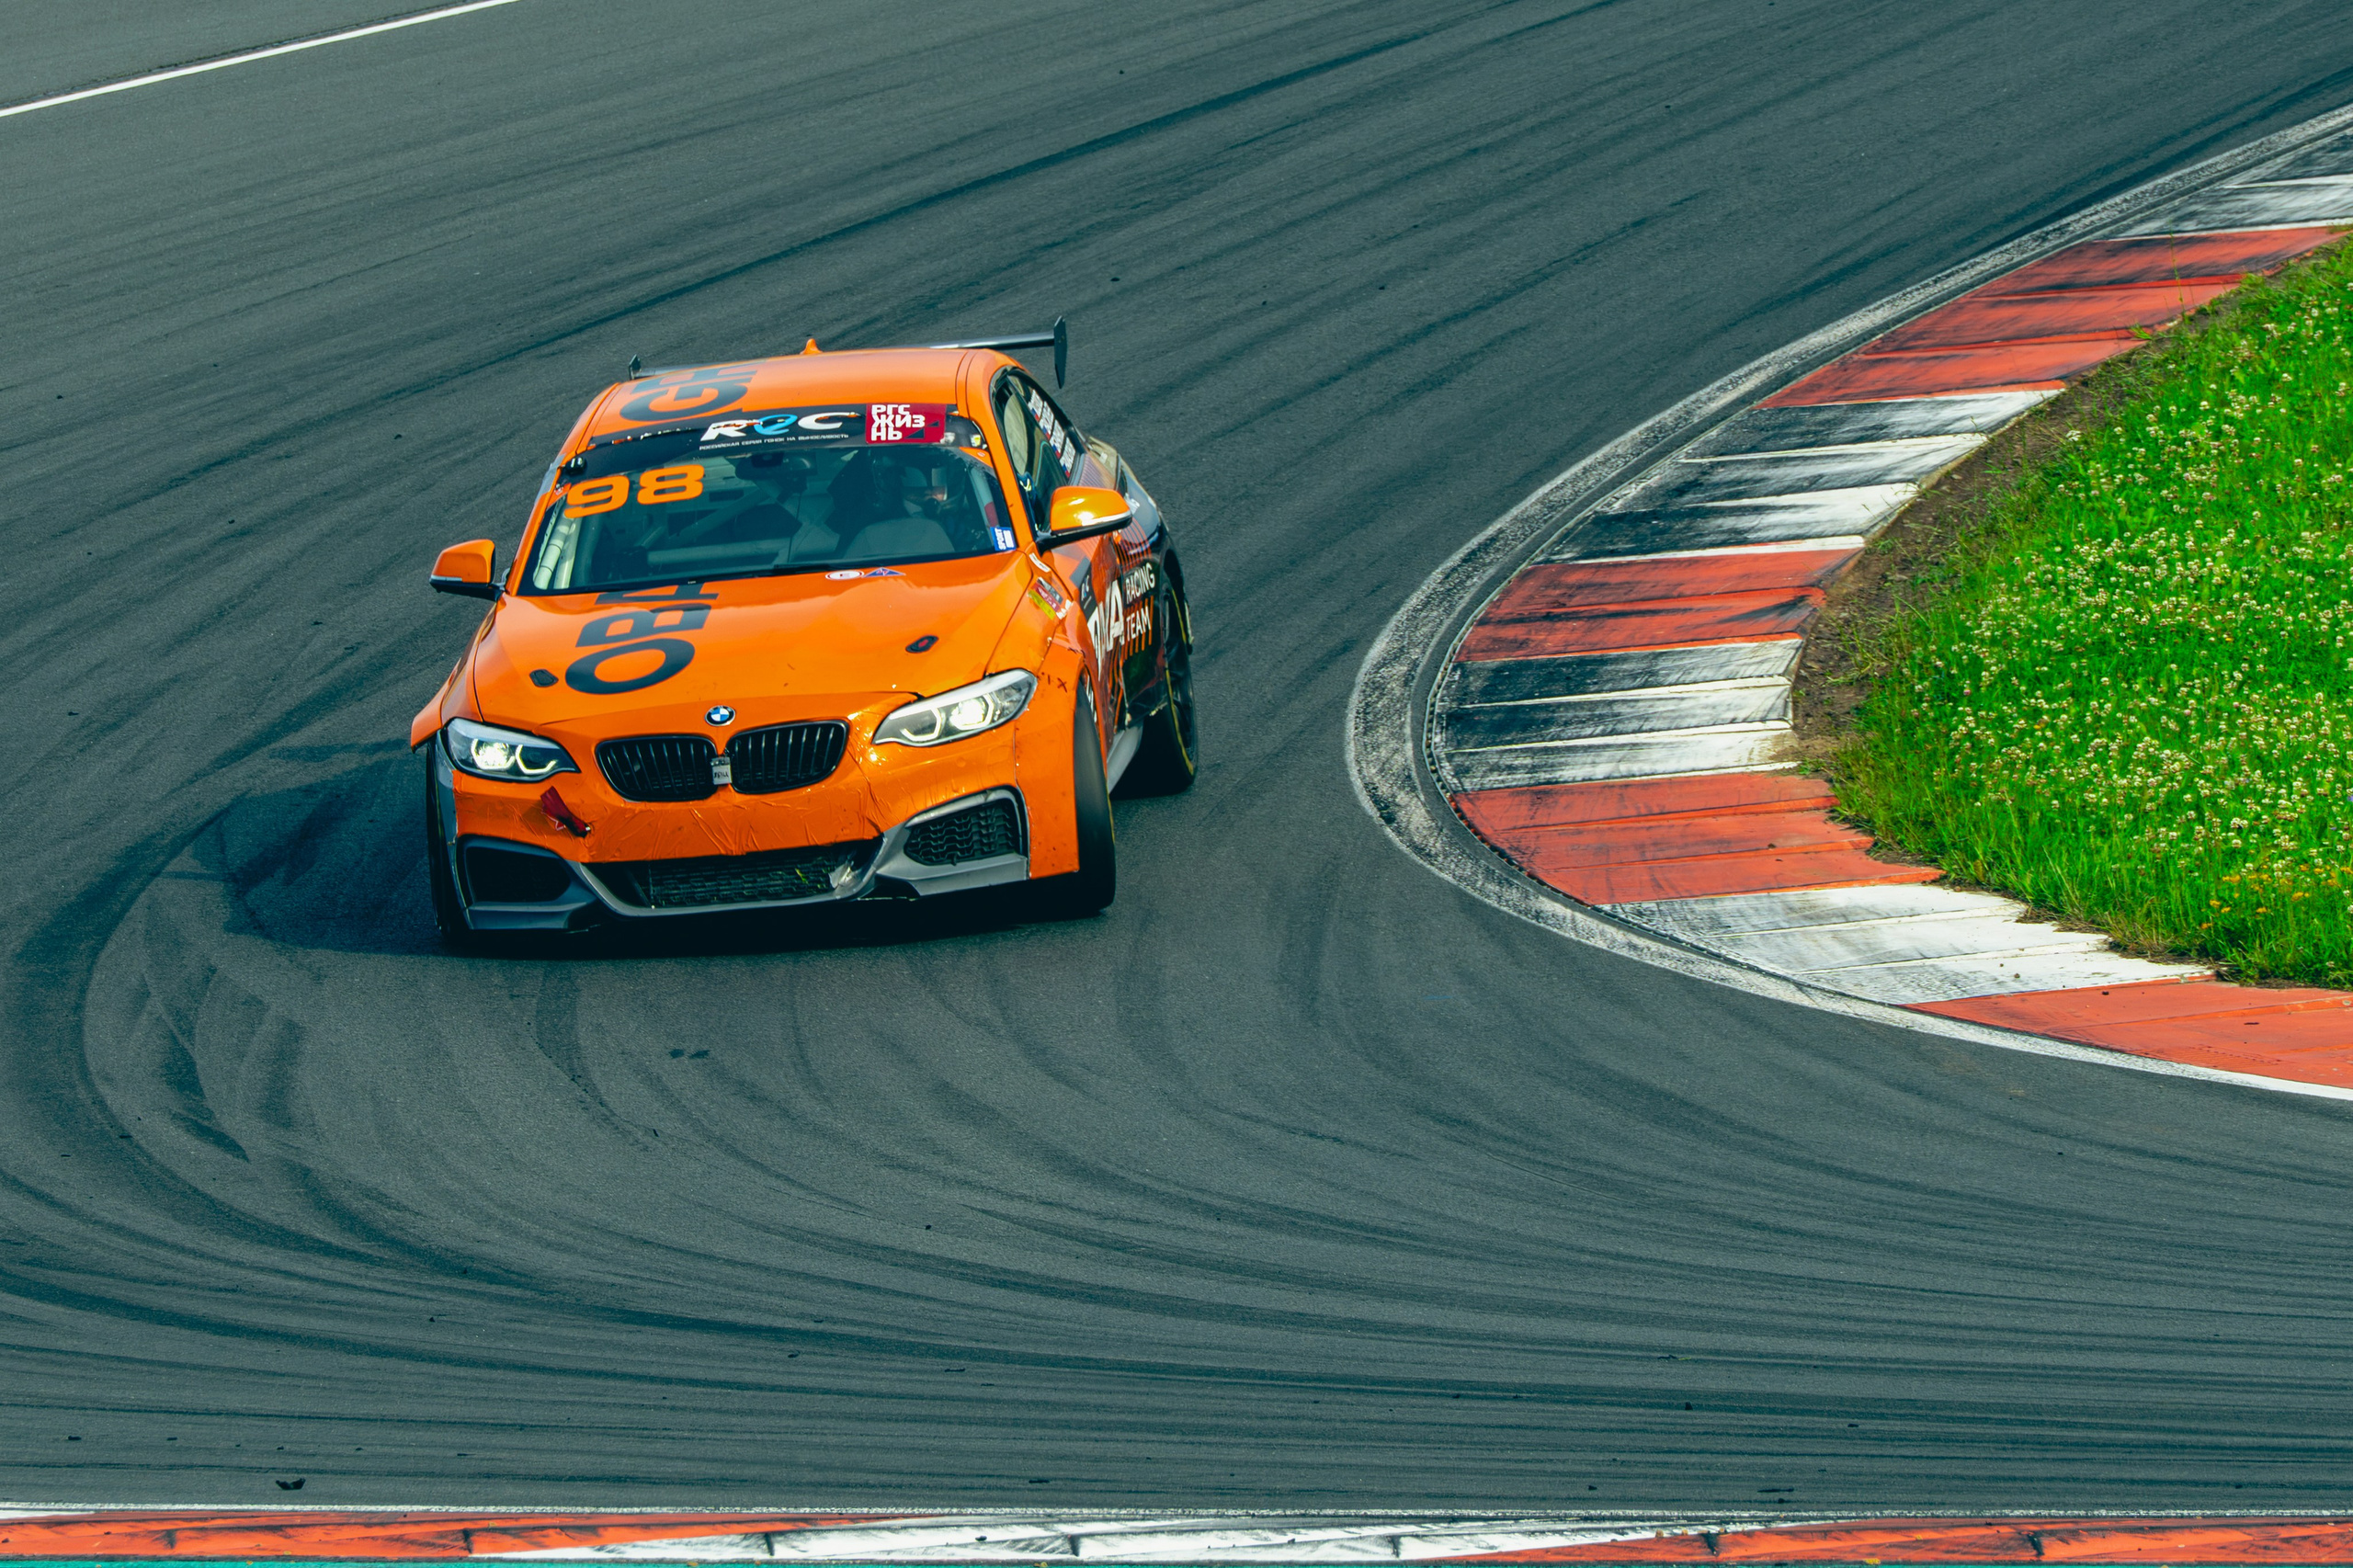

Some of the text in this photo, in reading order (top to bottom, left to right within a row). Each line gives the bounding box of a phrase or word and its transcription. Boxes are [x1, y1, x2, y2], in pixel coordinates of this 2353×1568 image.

[870, 404, 911, 415] РГС
[871, 414, 926, 428] ЖИЗ
[870, 426, 902, 441] НЬ
[699, 441, 740, 450] РОССИЙСКАЯ
[563, 464, 705, 518] 98
[1125, 562, 1155, 605] RACING
[1126, 606, 1152, 642] TEAM
